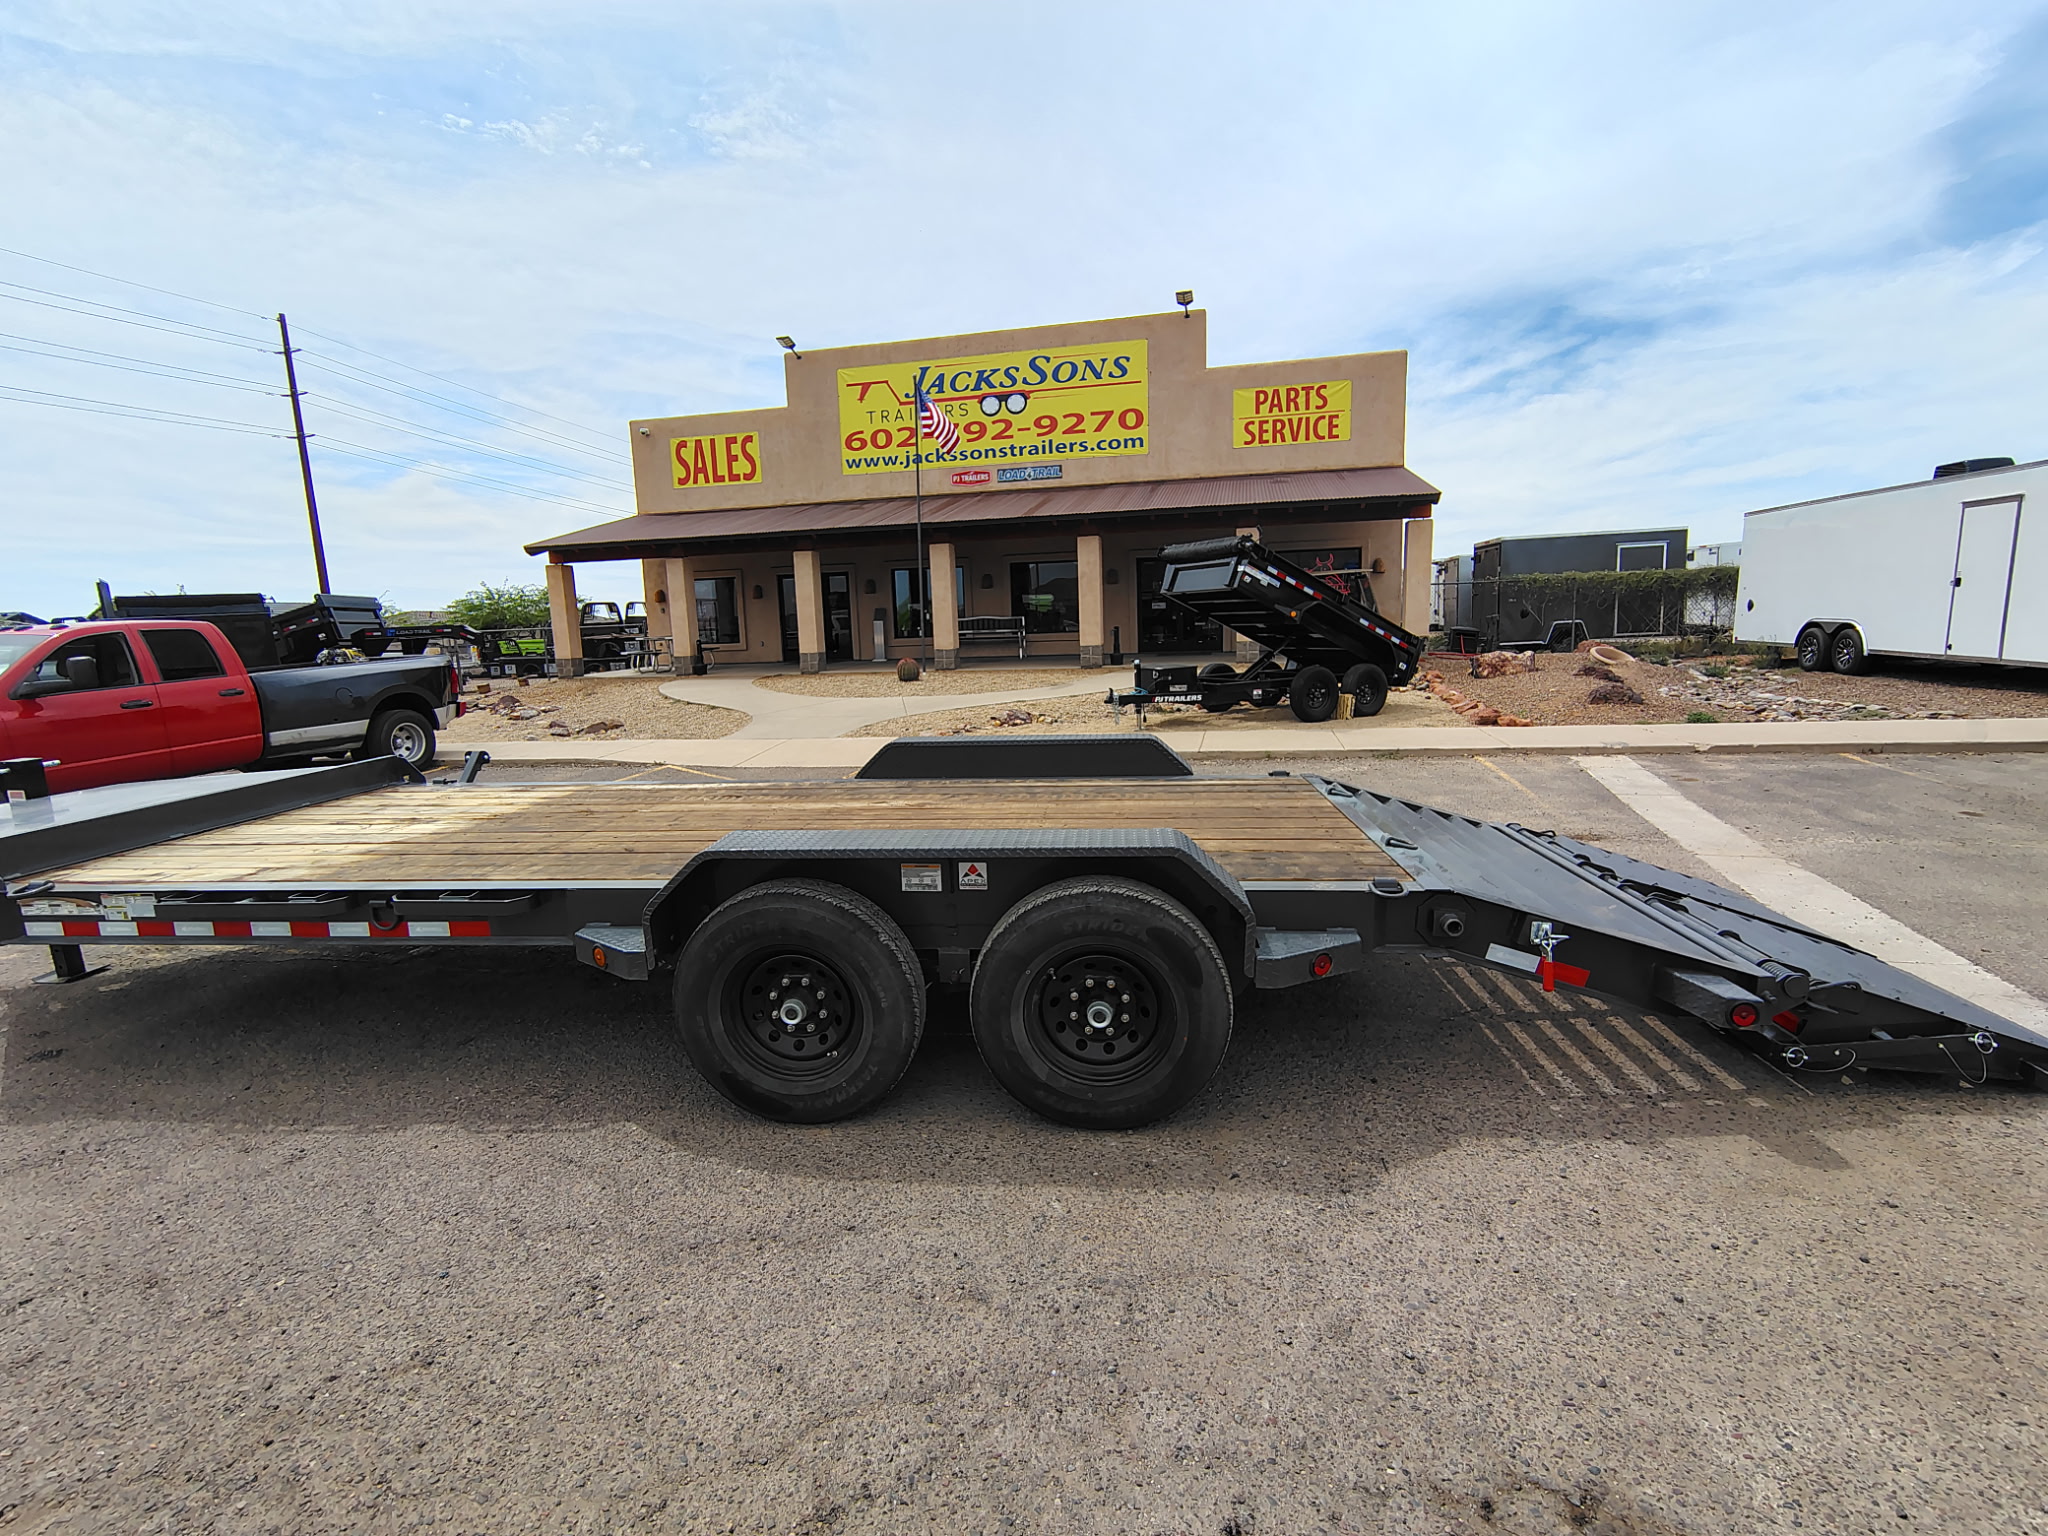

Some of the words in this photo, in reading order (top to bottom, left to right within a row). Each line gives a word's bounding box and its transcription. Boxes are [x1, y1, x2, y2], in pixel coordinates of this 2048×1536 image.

[866, 403, 969, 424] TRAIRS
[1255, 384, 1328, 415] PARTS
[844, 408, 1145, 451] 60292-9270
[1243, 414, 1340, 446] SERVICE
[675, 434, 757, 486] SALES
[845, 436, 1145, 469] www.jackssonstrailers.com
[961, 473, 989, 482] TRAILERS
[1031, 466, 1062, 479] TRAIL
